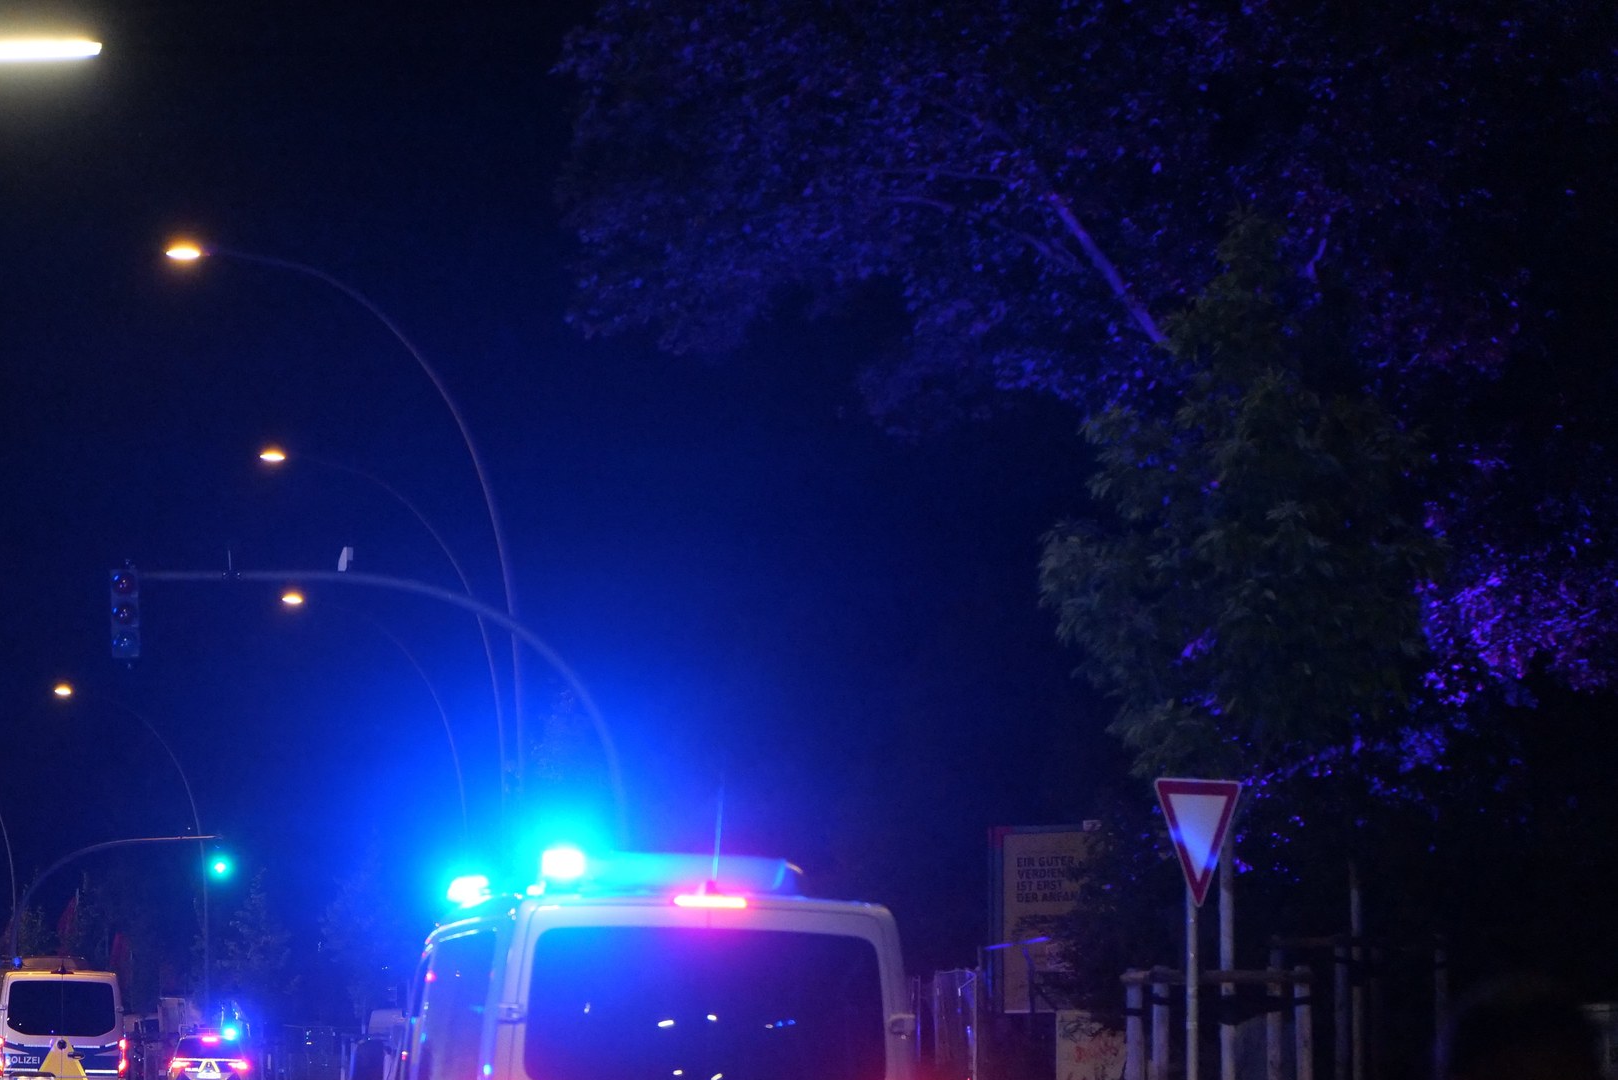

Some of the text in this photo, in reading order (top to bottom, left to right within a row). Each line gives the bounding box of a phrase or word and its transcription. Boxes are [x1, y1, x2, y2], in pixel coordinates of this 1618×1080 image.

[1016, 856, 1035, 868] EIN
[1016, 879, 1062, 891] IST ERST
[1016, 892, 1039, 903] DER
